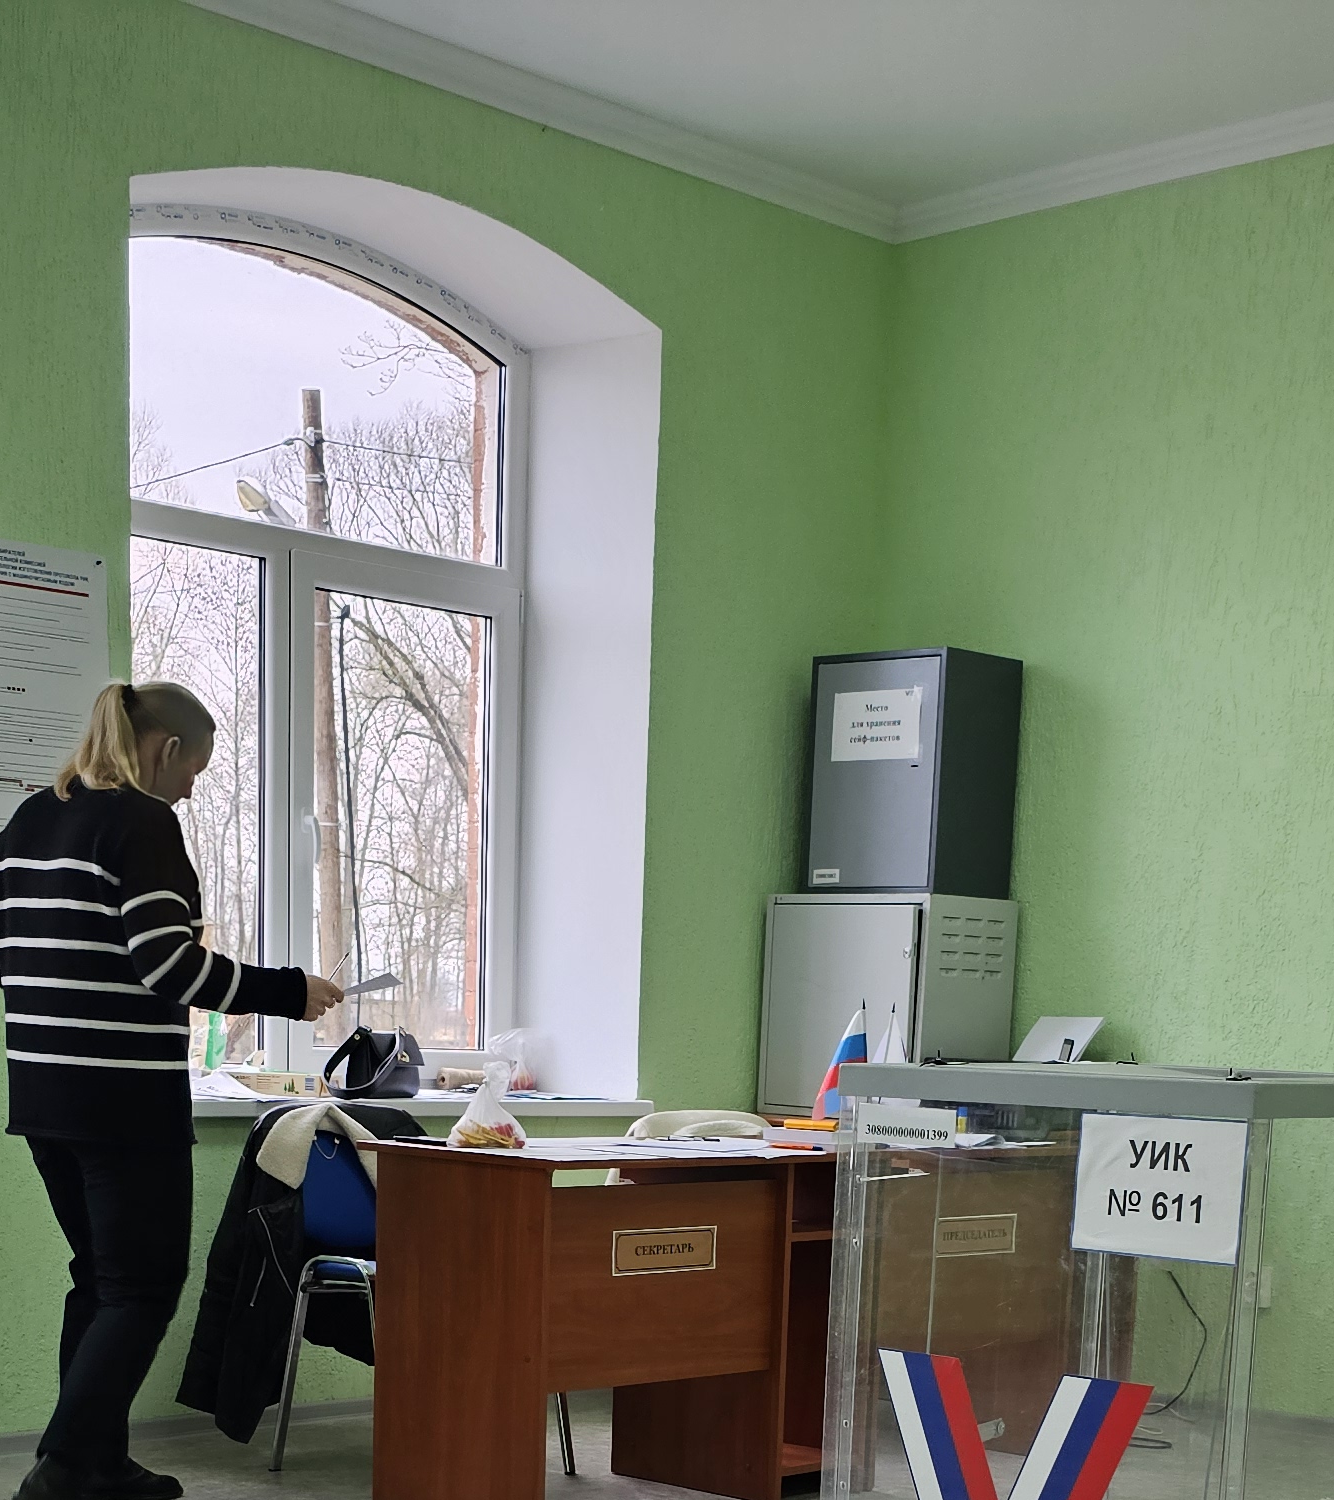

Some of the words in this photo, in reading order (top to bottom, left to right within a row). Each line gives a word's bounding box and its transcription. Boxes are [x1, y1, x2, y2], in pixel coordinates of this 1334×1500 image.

[865, 703, 888, 713] Место
[850, 721, 864, 729] для
[866, 720, 901, 730] хранения
[849, 734, 900, 745] сейф-пакетов
[865, 1124, 948, 1141] 308000000001399
[1129, 1139, 1193, 1172] УИК
[1107, 1189, 1141, 1217] №
[1151, 1191, 1202, 1224] 611
[634, 1242, 694, 1256] СЕКРЕТАРЬ
